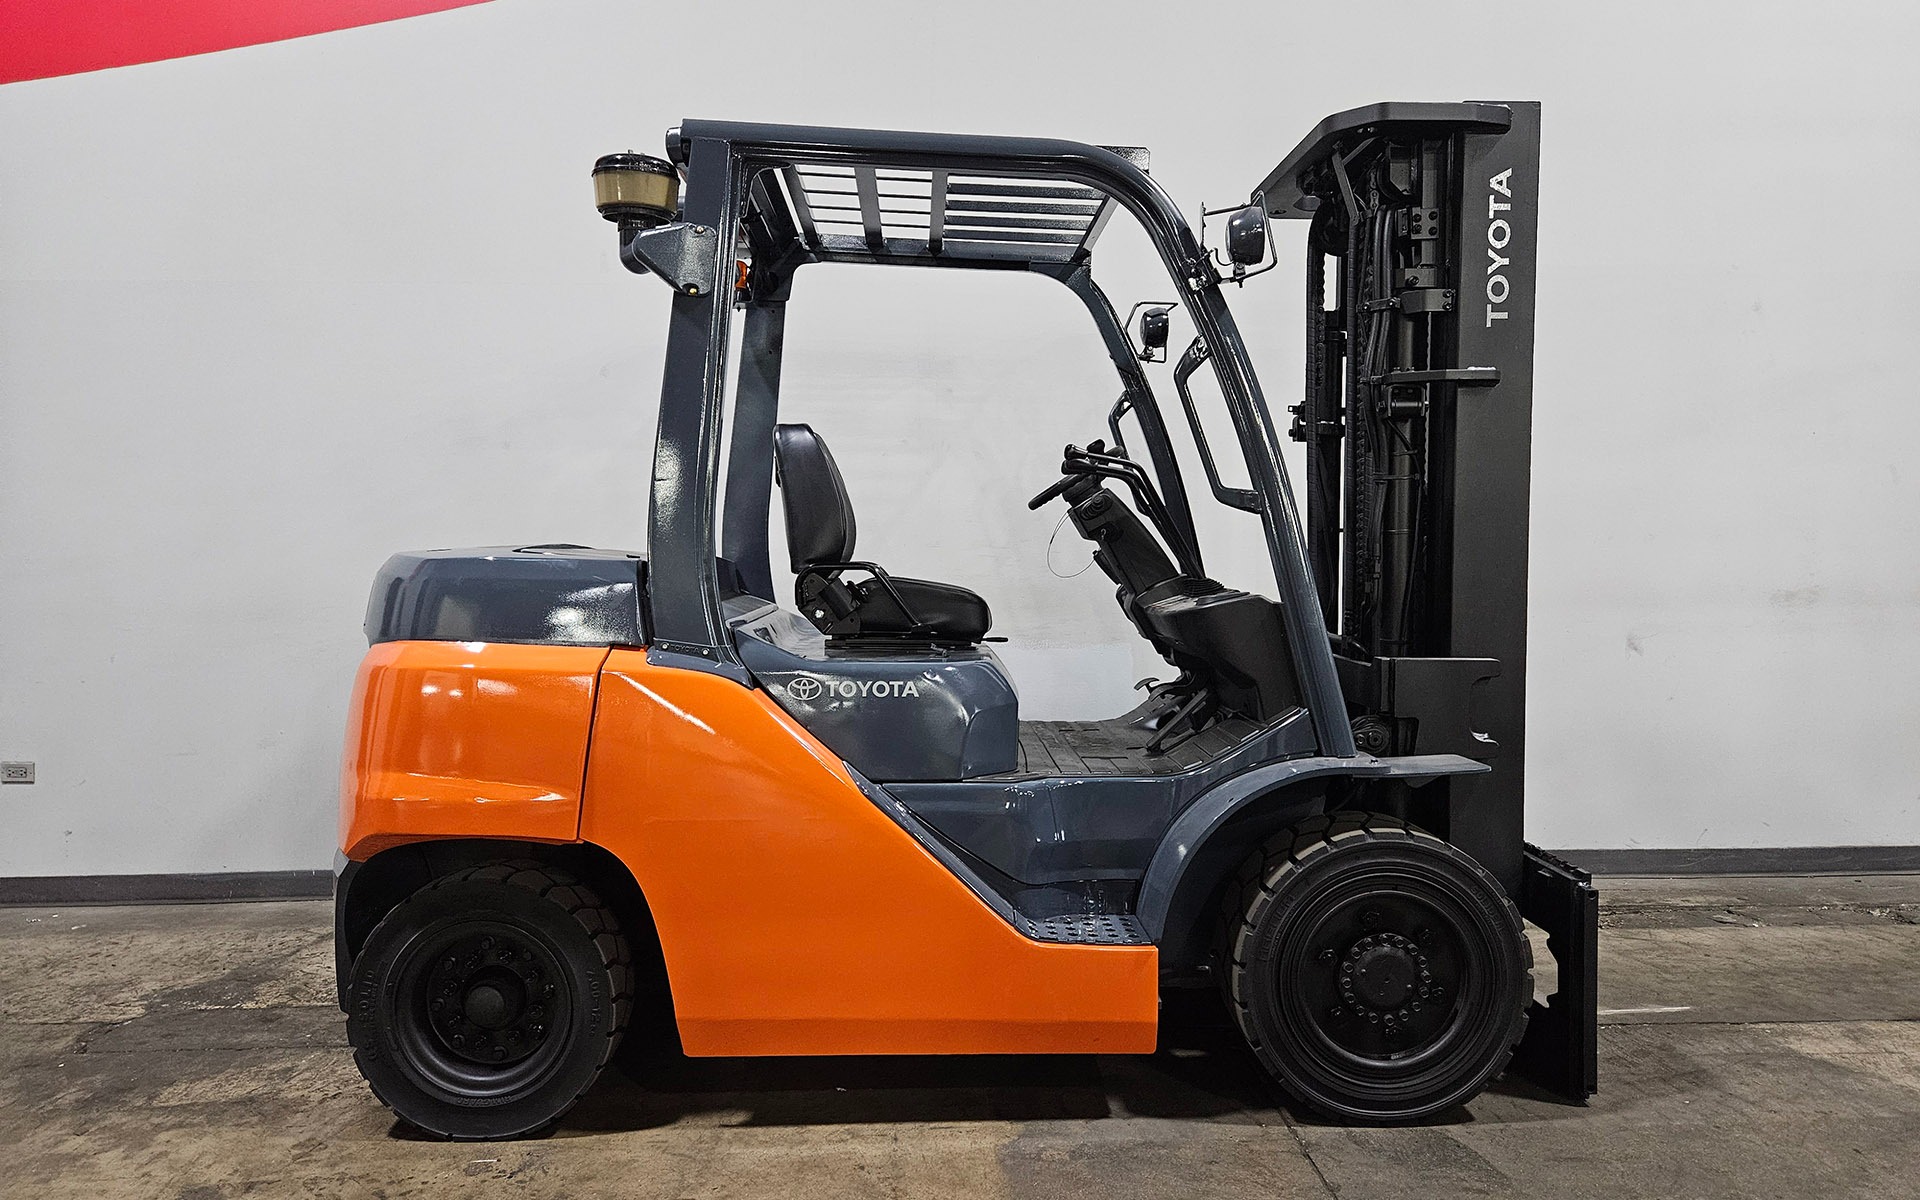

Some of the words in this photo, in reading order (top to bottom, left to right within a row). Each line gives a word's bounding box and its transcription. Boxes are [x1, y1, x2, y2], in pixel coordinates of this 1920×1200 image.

[1486, 167, 1512, 328] TOYOTA
[670, 643, 700, 653] TOYOTA
[825, 680, 919, 698] TOYOTA
